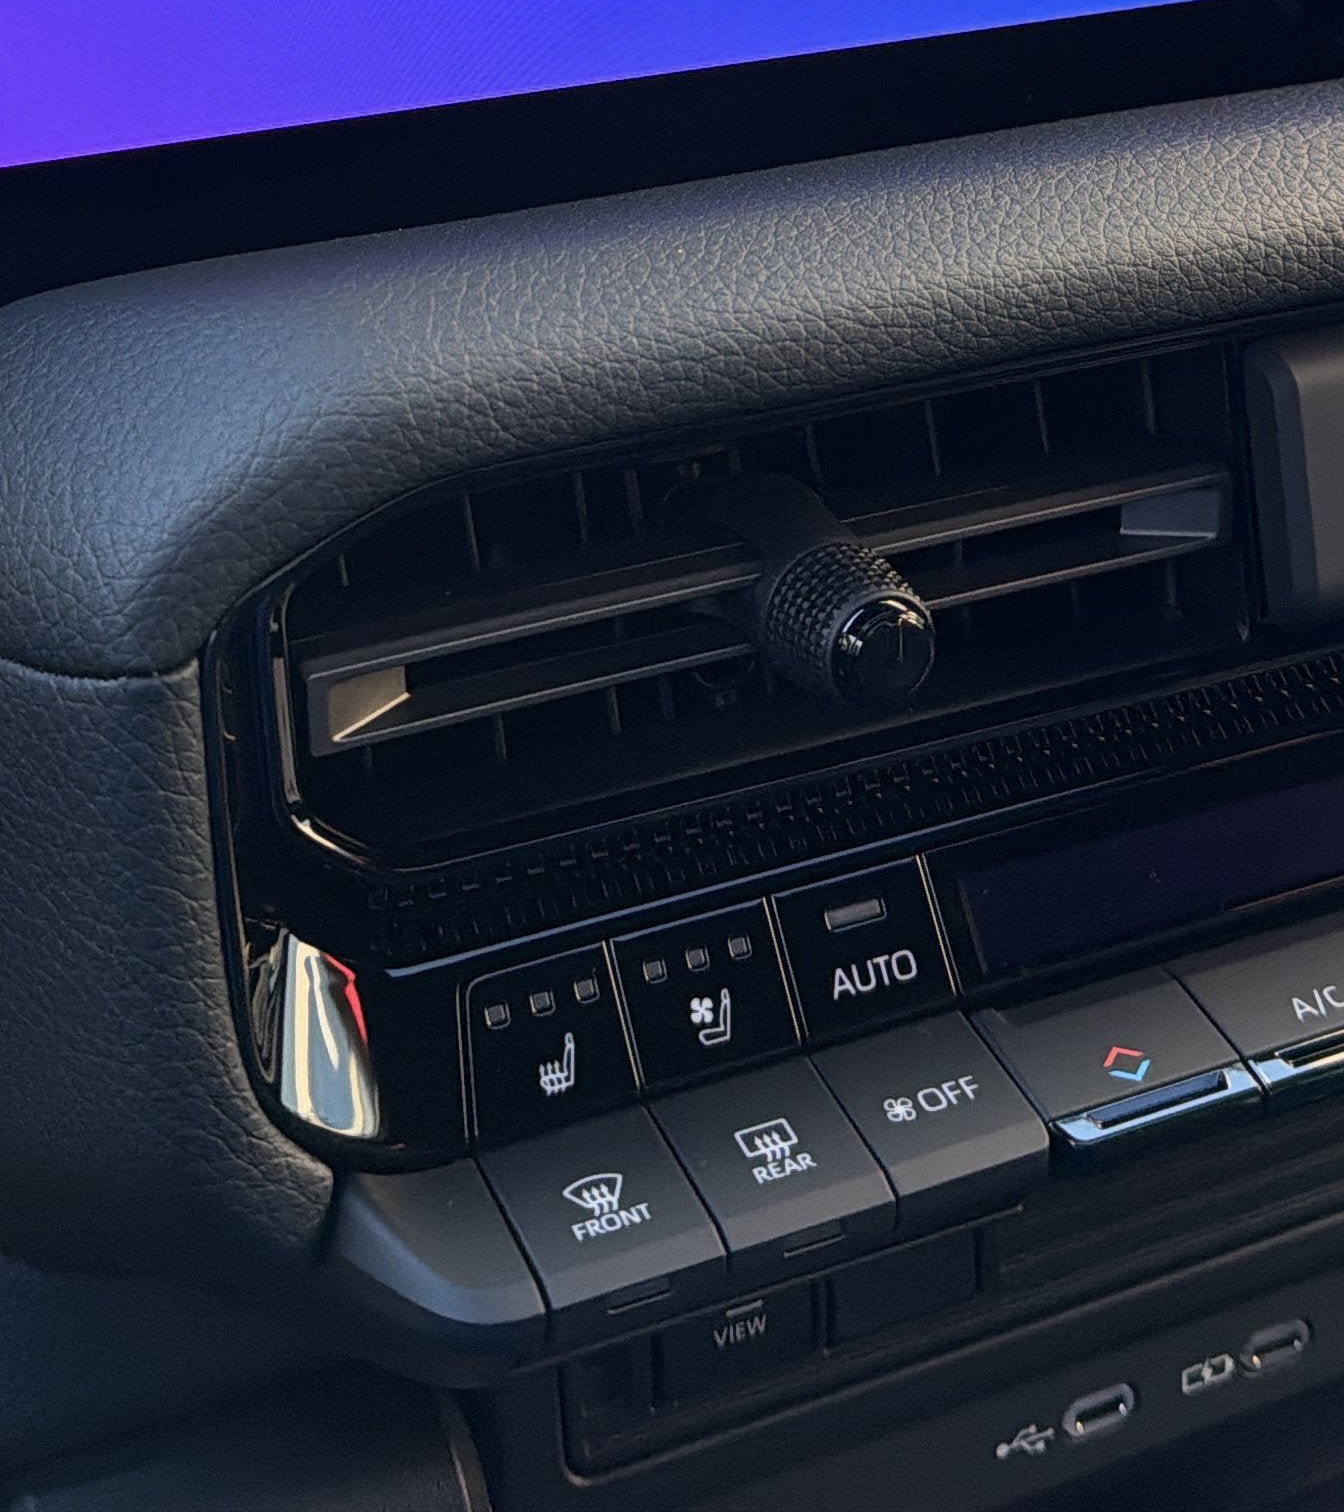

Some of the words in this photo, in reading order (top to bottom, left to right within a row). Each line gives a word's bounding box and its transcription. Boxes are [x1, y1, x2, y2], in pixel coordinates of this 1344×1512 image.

[831, 948, 918, 1001] AUTO
[917, 1075, 979, 1115] OFF
[752, 1151, 817, 1185] REAR
[571, 1202, 653, 1243] FRONT
[713, 1314, 768, 1349] VIEW
